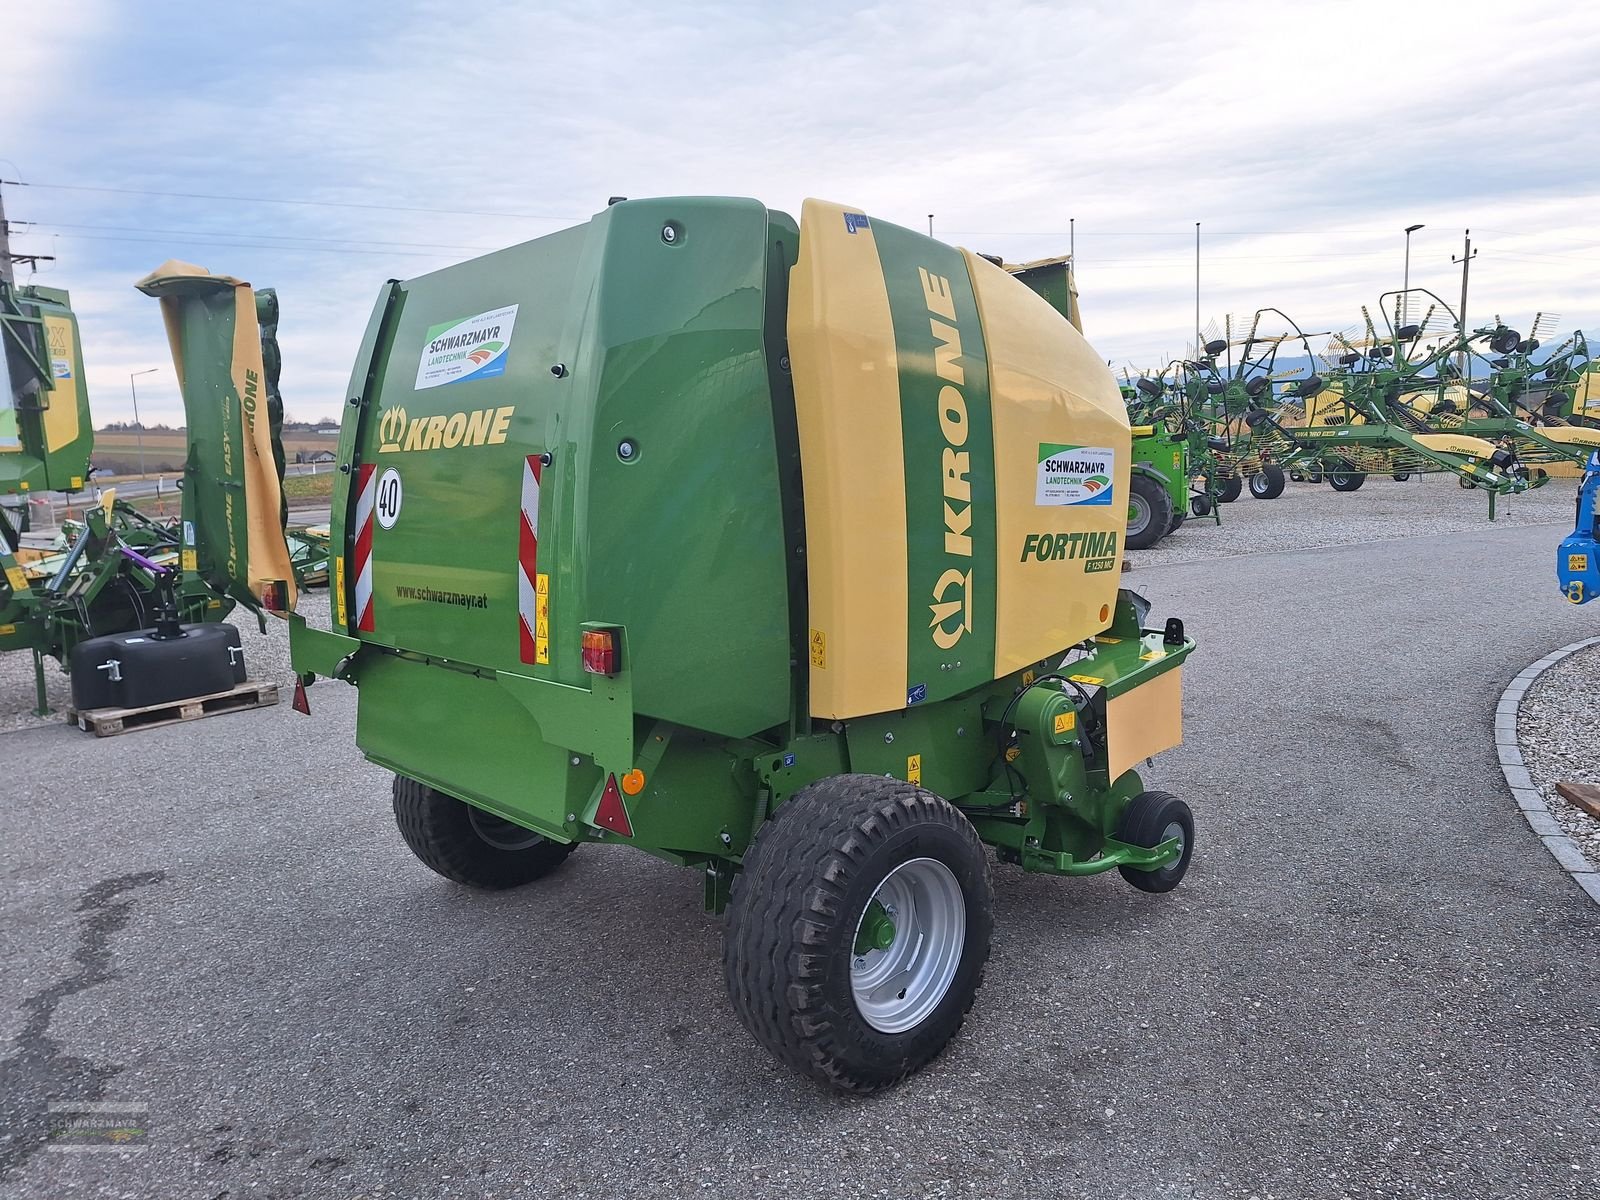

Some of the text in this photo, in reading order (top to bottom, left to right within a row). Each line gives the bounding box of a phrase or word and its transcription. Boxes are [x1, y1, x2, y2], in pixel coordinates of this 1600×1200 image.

[429, 326, 501, 354] SCHWARZMAYR
[427, 350, 468, 367] LANDTECHNIK
[919, 266, 973, 557] KRONE
[403, 405, 515, 451] KRONE
[1456, 447, 1479, 455] KRONE
[1045, 459, 1105, 474] SCHWARZMAYR
[1045, 476, 1083, 485] LANDTECHNIK
[379, 478, 398, 518] 40
[1020, 531, 1117, 562] FORTIMA
[1086, 561, 1113, 571] F 1250 MC
[396, 585, 488, 610] www.schwarzmayr.at
